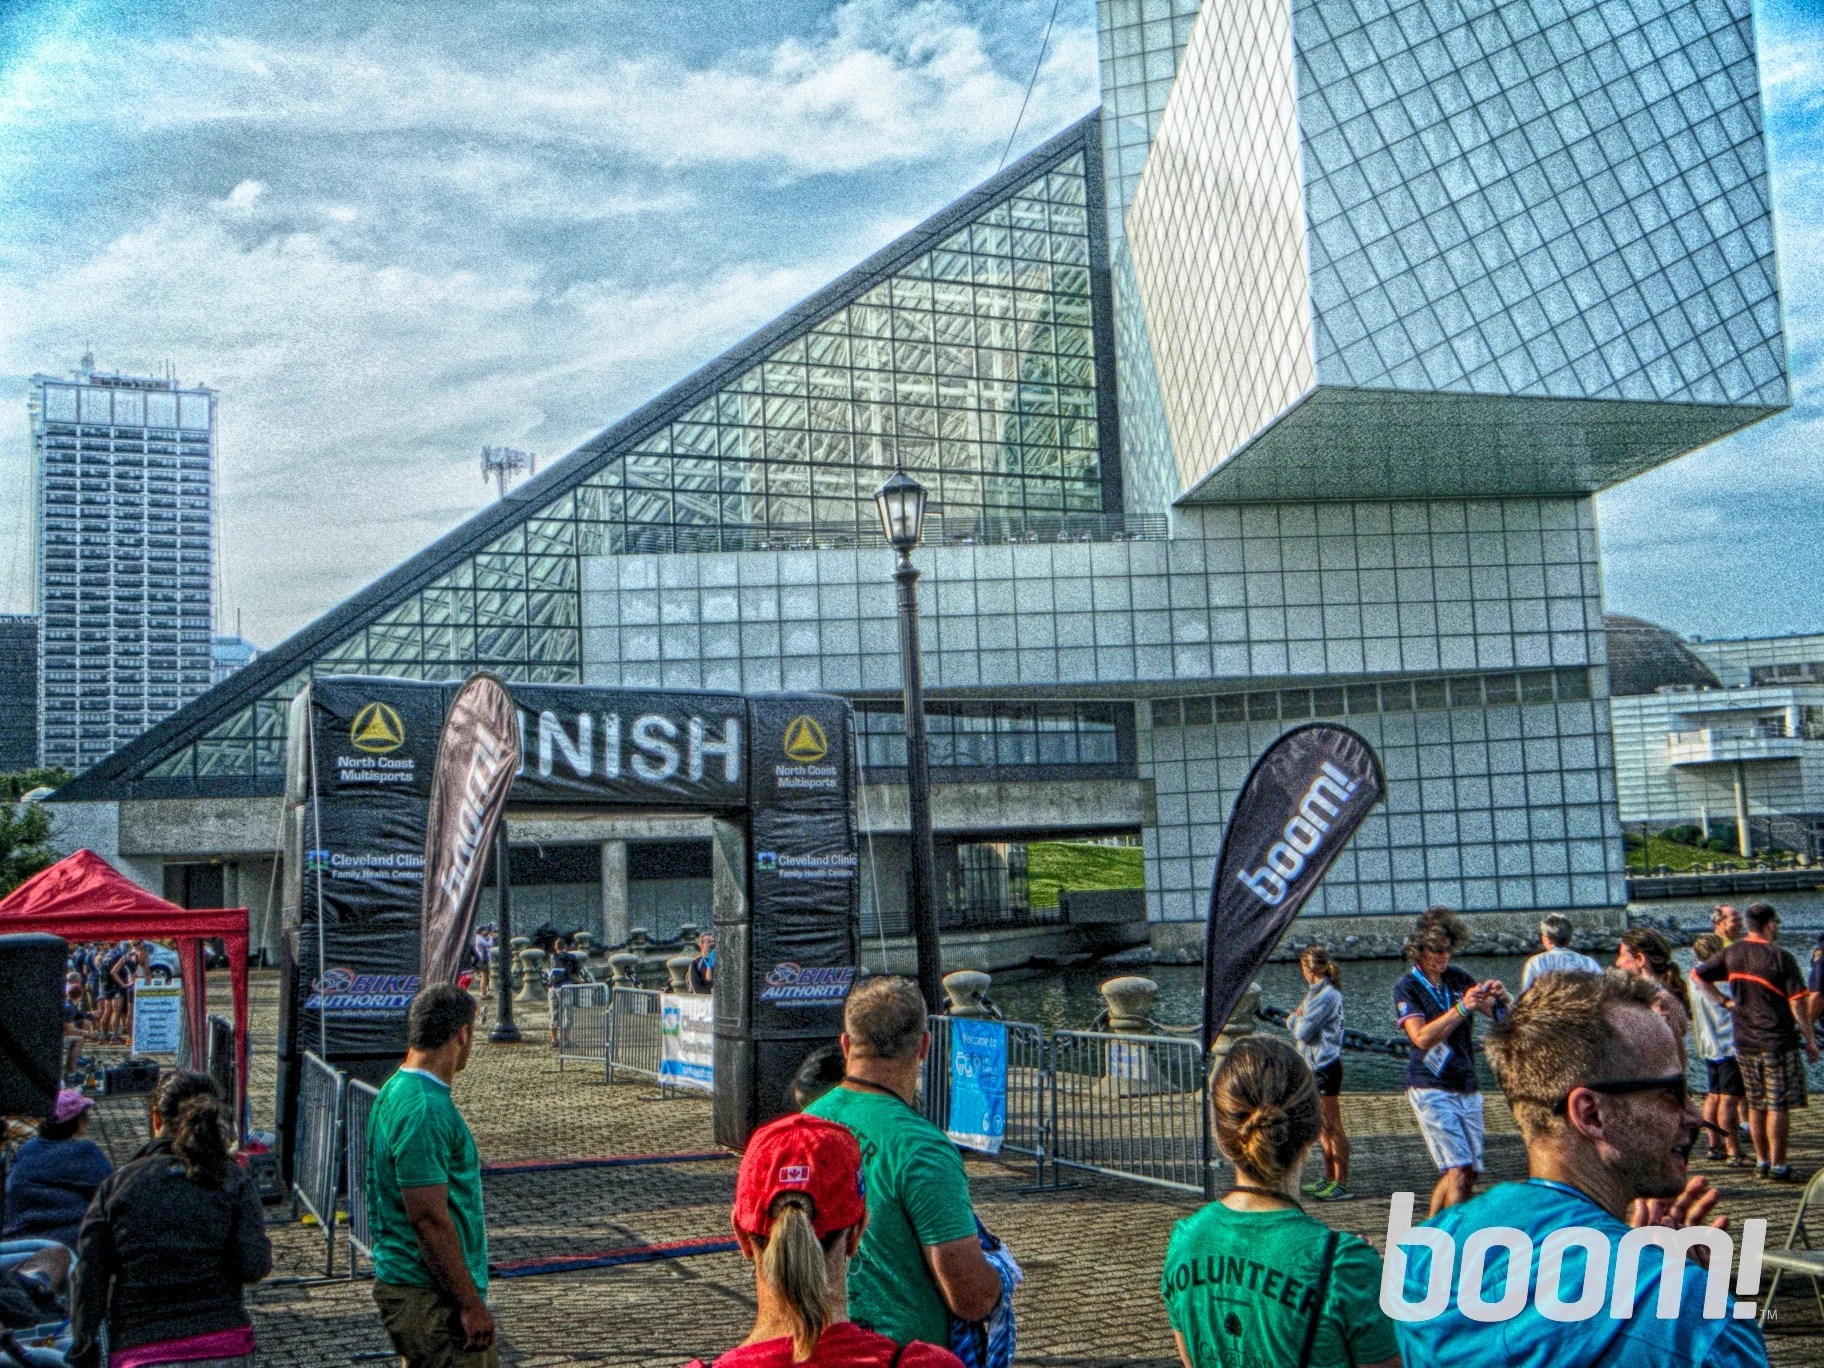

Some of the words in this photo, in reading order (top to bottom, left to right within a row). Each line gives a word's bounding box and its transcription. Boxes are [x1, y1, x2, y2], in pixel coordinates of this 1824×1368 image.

[516, 710, 739, 782] NISH
[338, 756, 375, 768] North
[378, 756, 415, 768] Coast
[341, 769, 414, 783] Multisports
[775, 764, 806, 776] North
[807, 765, 837, 776] Coast
[778, 777, 837, 789] Multisports
[1236, 760, 1357, 905] boom!
[331, 853, 394, 866] Cleveland
[779, 855, 829, 866] Cleveland
[831, 854, 858, 865] Clinic
[332, 870, 361, 879] Family
[362, 870, 390, 878] Health
[391, 870, 424, 879] Centers
[779, 869, 802, 878] Family
[804, 869, 827, 877] Health
[827, 869, 853, 877] Centers
[796, 967, 857, 984] BIKE
[348, 975, 422, 993] BIKE
[762, 985, 848, 997] AUTHORITY
[306, 994, 414, 1007] AUTHORITY
[324, 1009, 406, 1017] www.BikeAuthority.com
